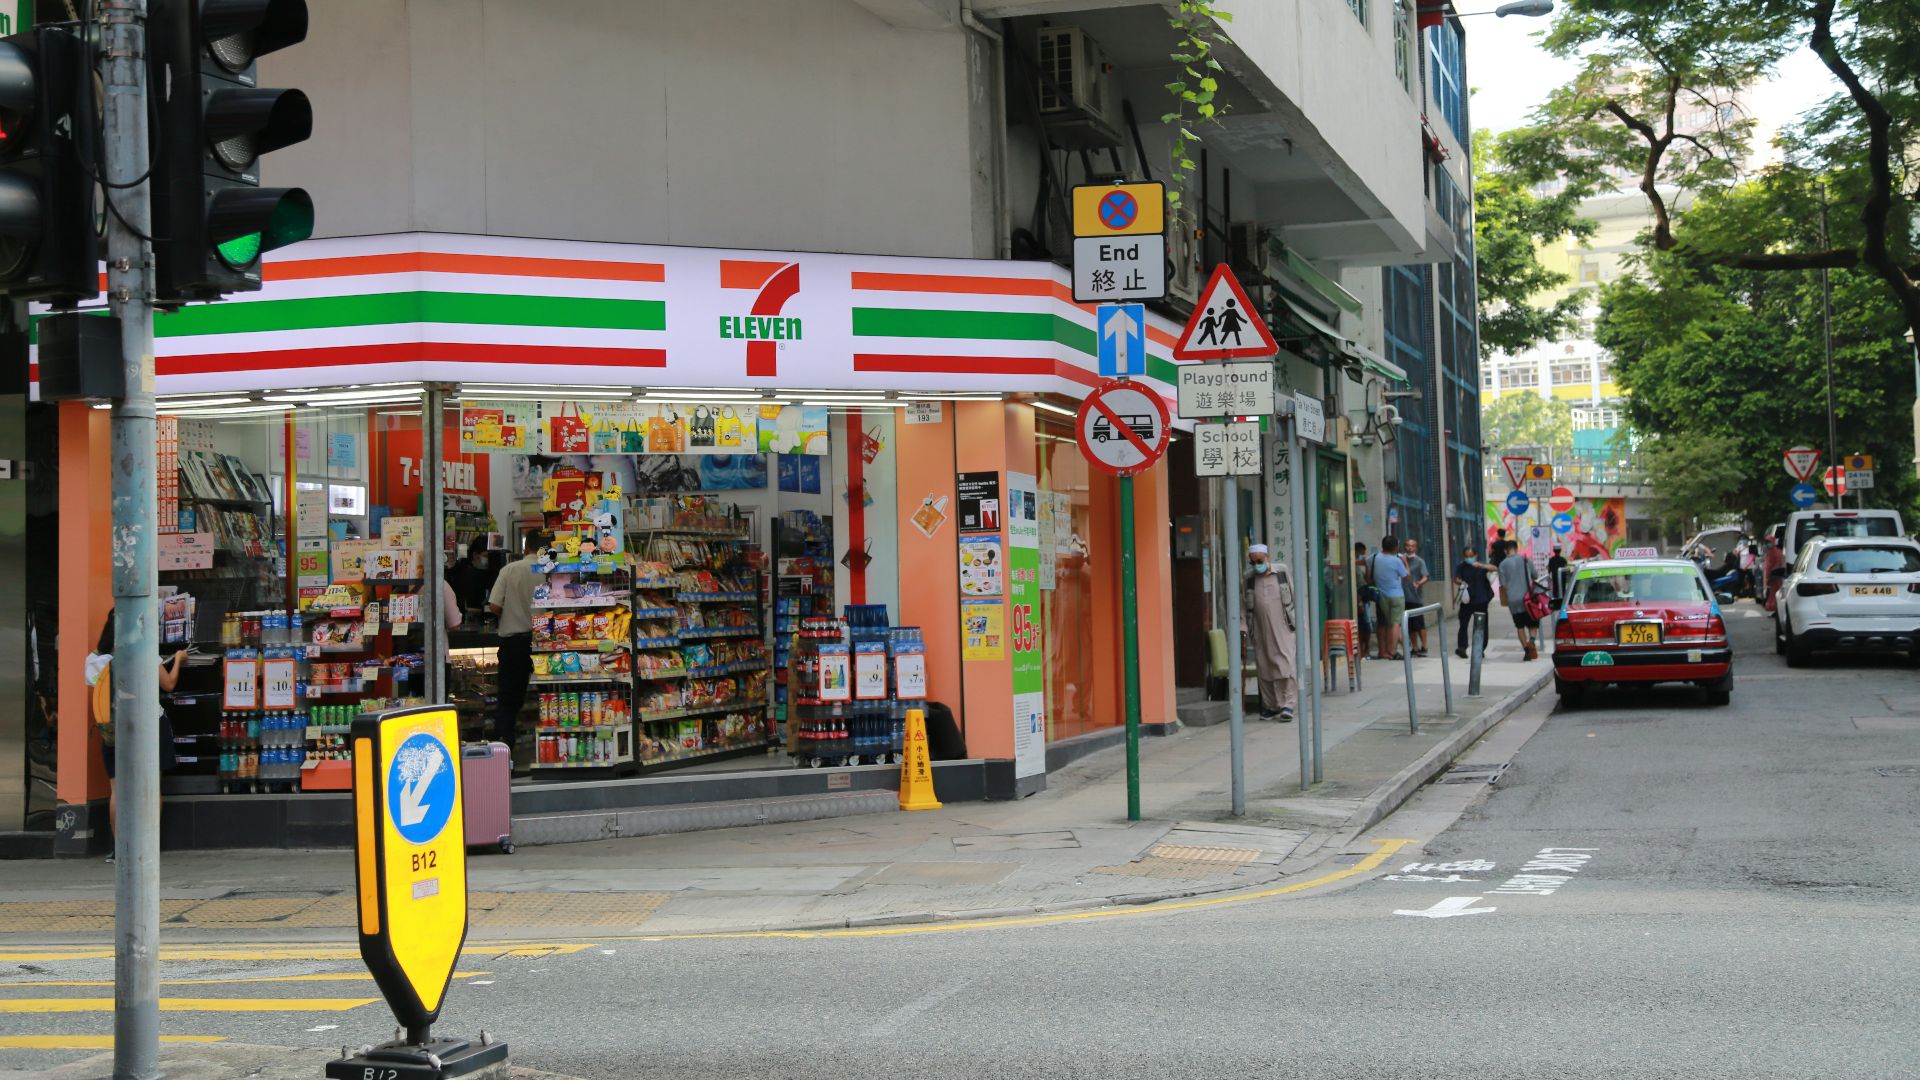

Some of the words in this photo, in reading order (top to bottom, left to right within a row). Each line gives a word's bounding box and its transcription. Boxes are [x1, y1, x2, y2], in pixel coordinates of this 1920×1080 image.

[1100, 244, 1139, 261] End
[1091, 268, 1147, 293] 終止
[720, 260, 801, 376] 7
[720, 316, 802, 340] ELEVEn
[1183, 371, 1268, 386] Playground
[1196, 391, 1257, 409] 遊樂場
[1202, 430, 1254, 443] School
[1202, 447, 1257, 469] 學校
[1618, 548, 1655, 558] TAXI
[1854, 587, 1868, 595] RG
[1631, 625, 1647, 633] KC
[1627, 633, 1654, 643] 3718
[412, 850, 437, 872] B12
[1520, 847, 1600, 872] LOOK
[363, 1067, 398, 1080] B12
